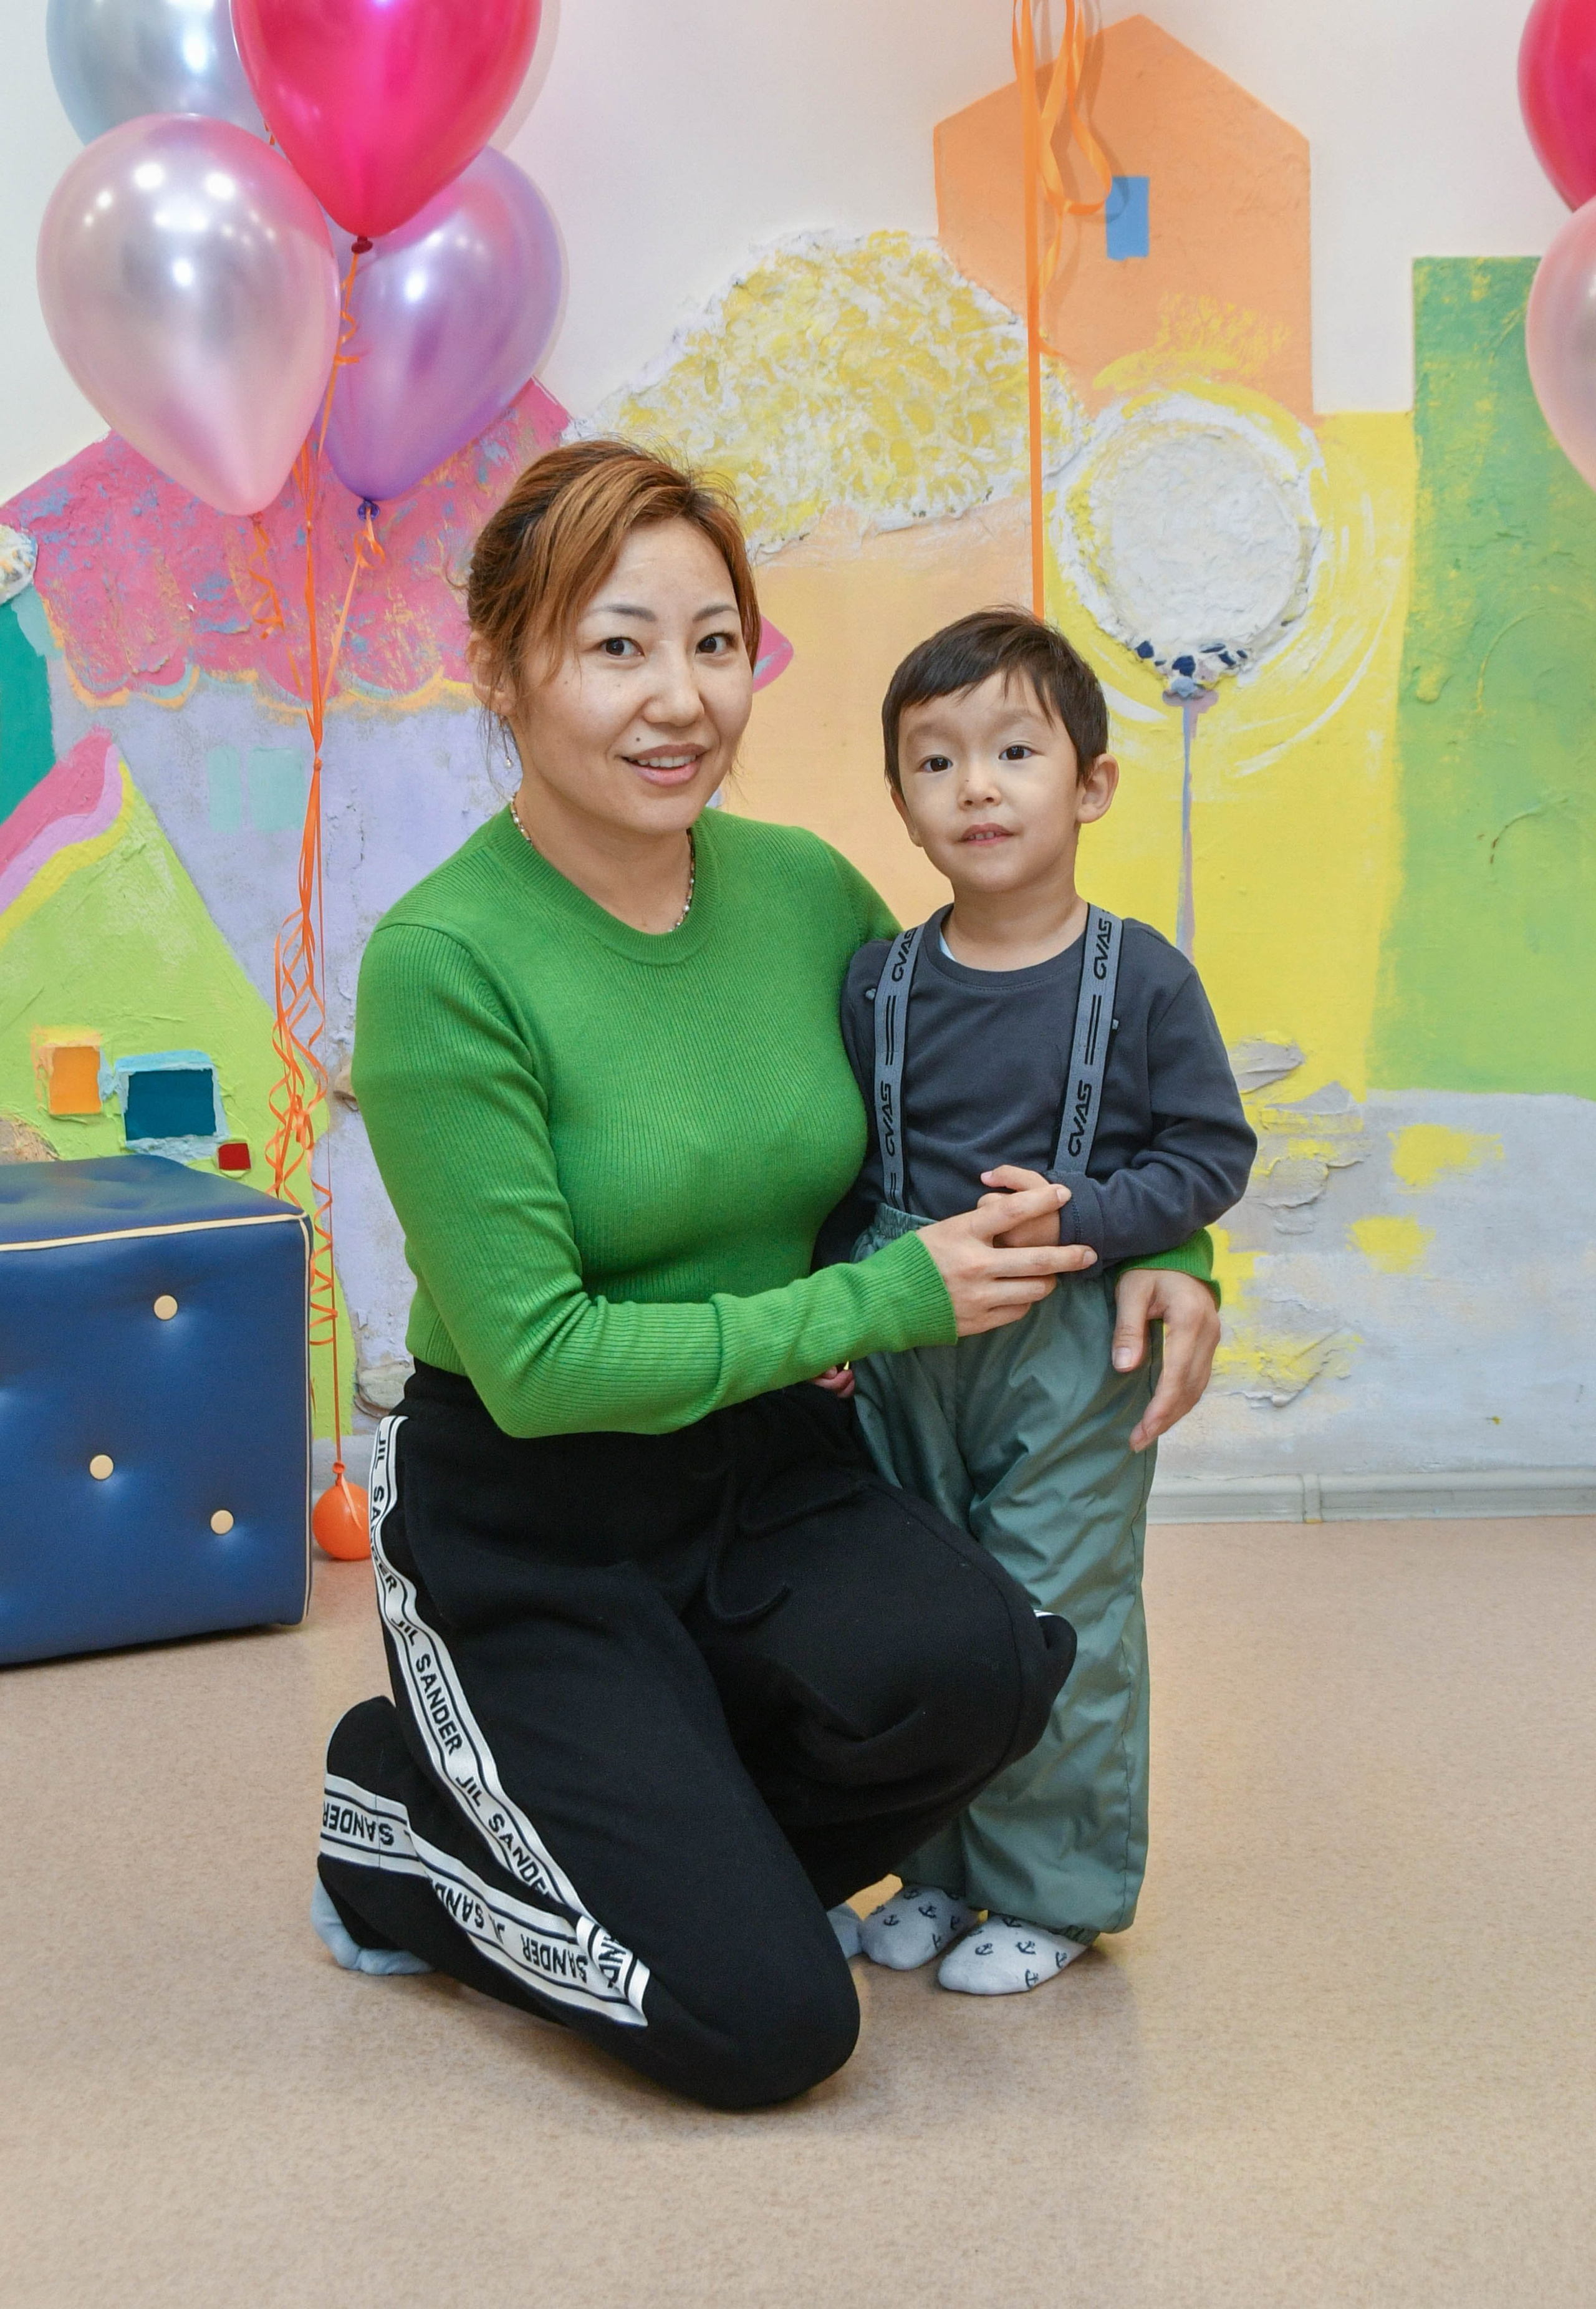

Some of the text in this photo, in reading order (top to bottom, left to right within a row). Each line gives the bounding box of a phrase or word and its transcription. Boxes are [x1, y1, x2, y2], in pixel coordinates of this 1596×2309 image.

[375, 1430, 387, 1468] JIL
[391, 1617, 418, 1646] JIL
[415, 1653, 463, 1755] SANDER
[456, 1775, 484, 1807] JIL
[488, 1813, 552, 1898] SANDE
[322, 1800, 395, 1846] SANDER
[520, 1934, 588, 1984] SANDER
